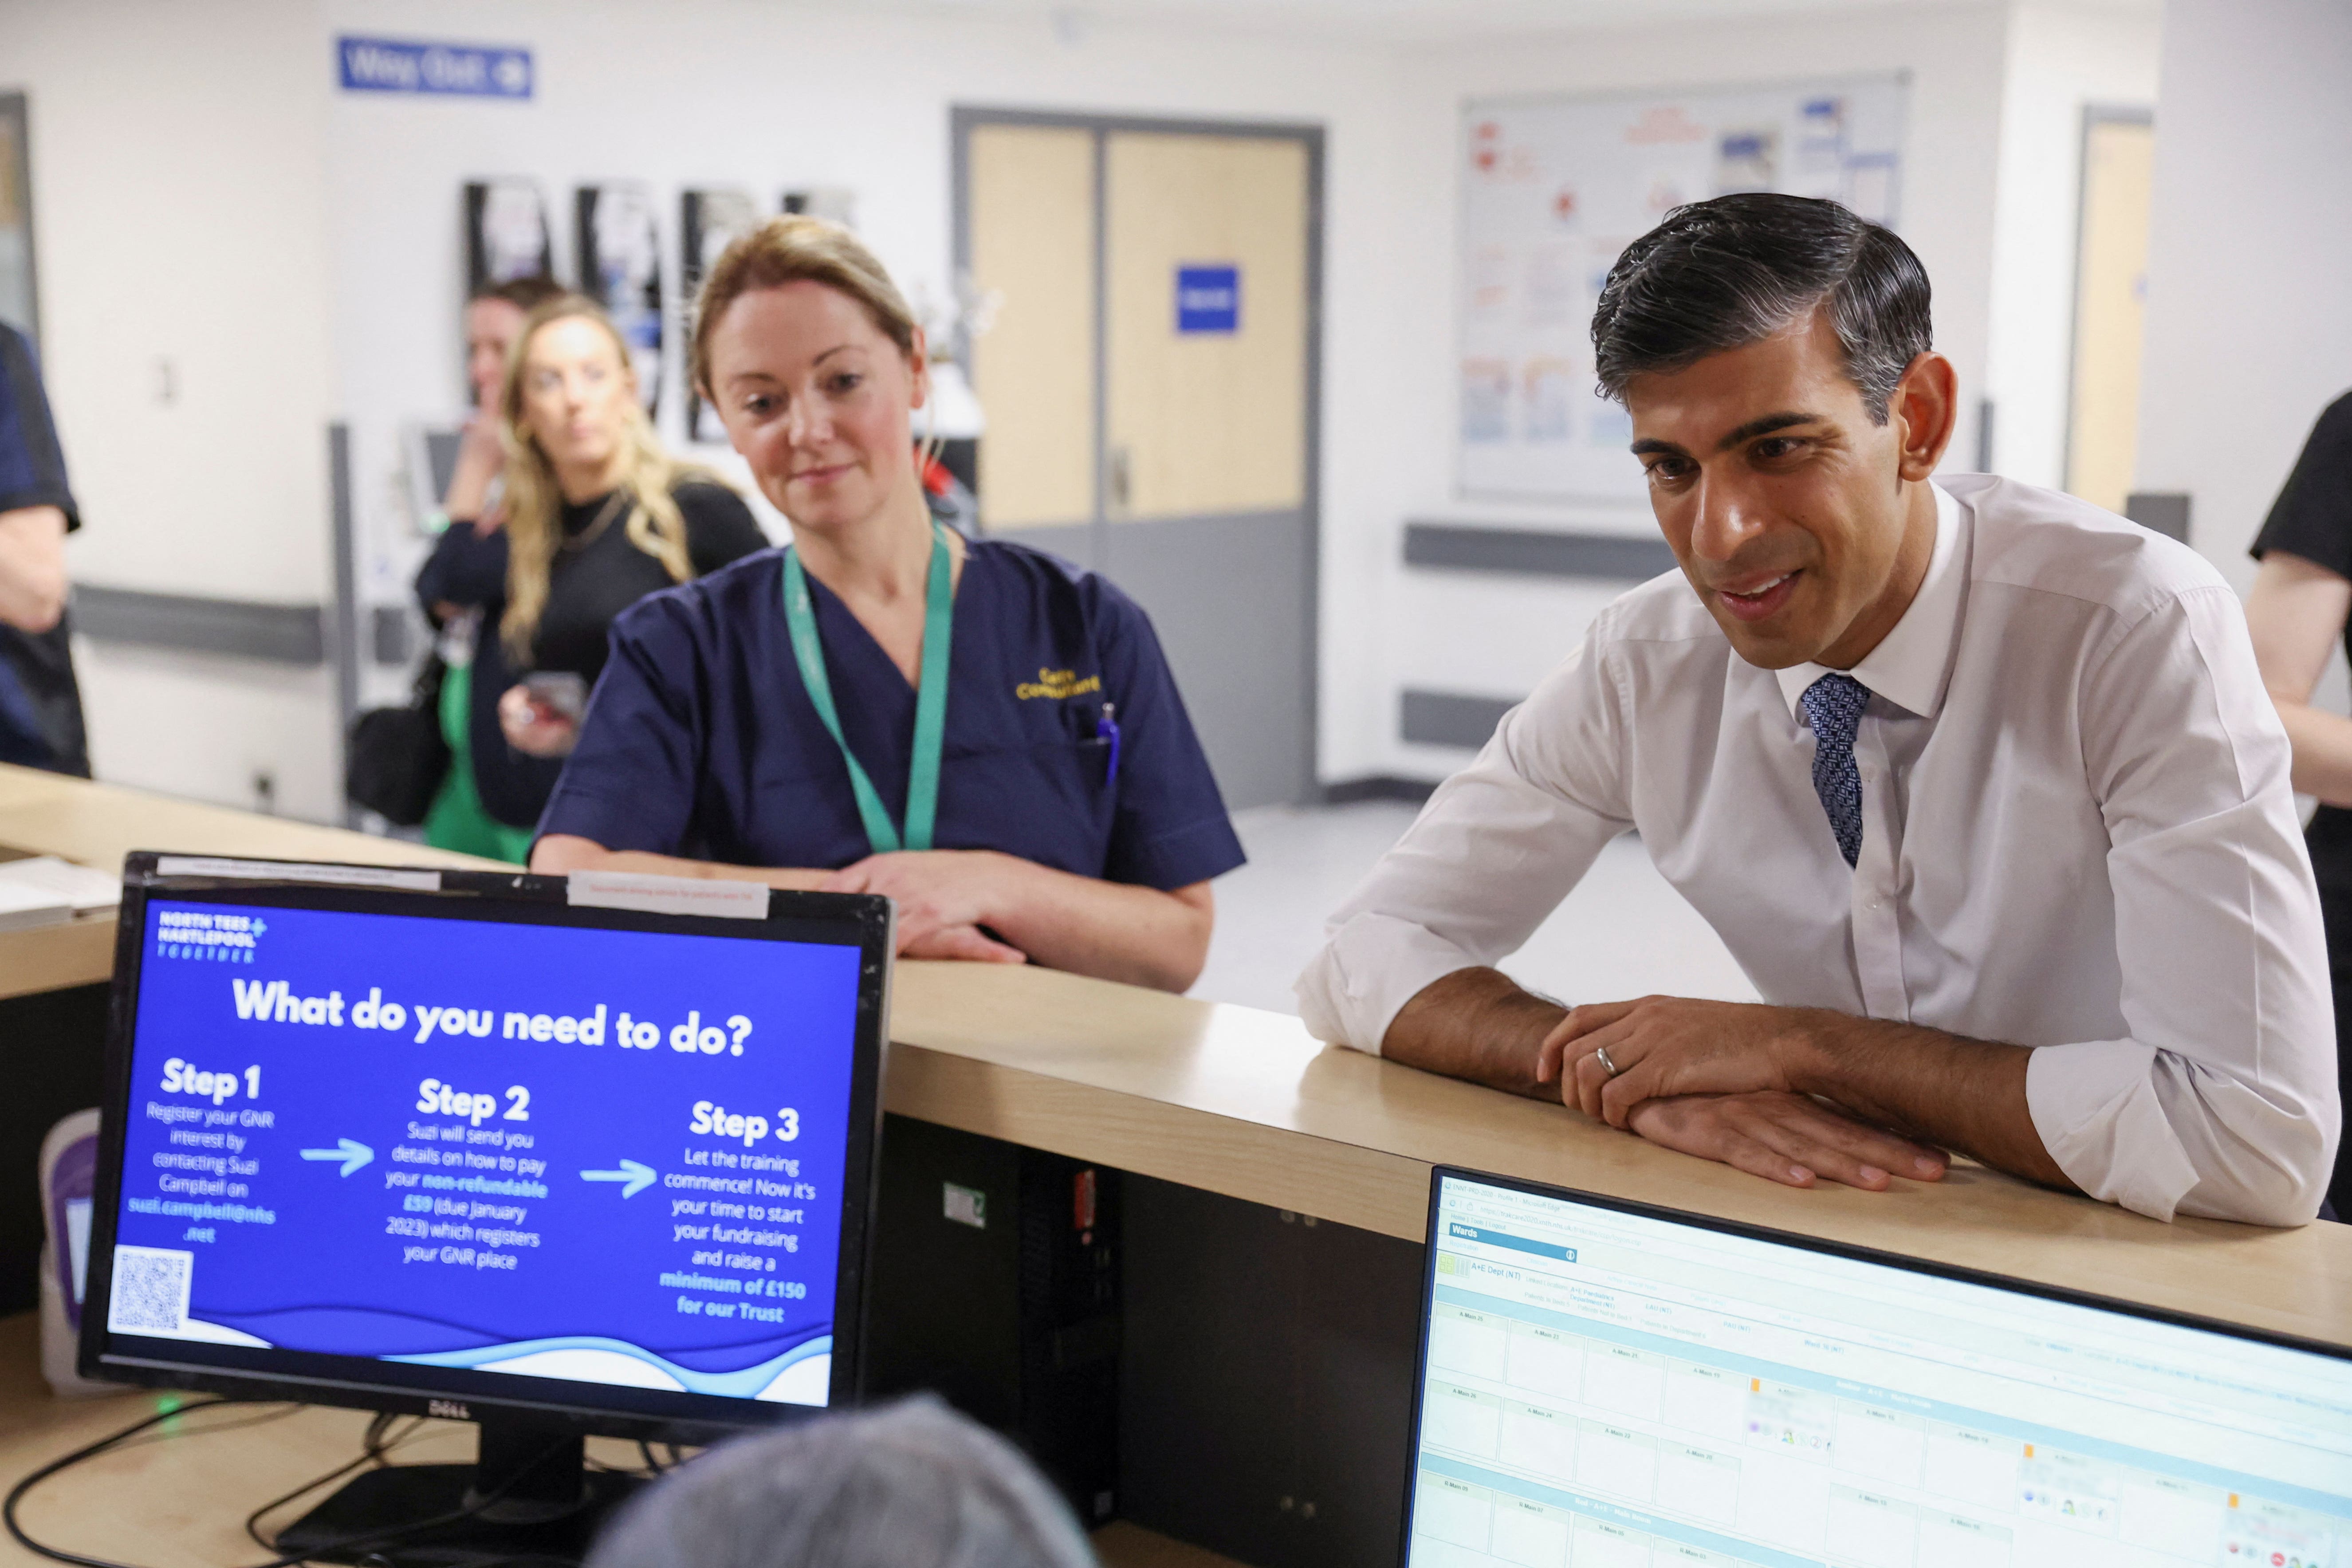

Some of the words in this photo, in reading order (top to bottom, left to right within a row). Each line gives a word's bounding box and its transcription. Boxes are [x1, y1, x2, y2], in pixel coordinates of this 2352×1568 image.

[159, 911, 213, 929] NORTH
[213, 914, 251, 932] TEES
[158, 927, 256, 948] HARTLEPOOL
[232, 979, 345, 1027] What
[351, 987, 406, 1032] do
[414, 1005, 493, 1044] you
[502, 1003, 607, 1046] need
[616, 1012, 661, 1050] to
[669, 1011, 753, 1057] do?
[160, 1057, 238, 1106] Step
[244, 1065, 261, 1099] 1
[146, 1101, 203, 1124] Register
[204, 1109, 240, 1128] your
[240, 1109, 275, 1128] GNR
[416, 1077, 496, 1127] Step
[503, 1084, 530, 1121] 2
[407, 1121, 439, 1141] Suzi
[440, 1125, 465, 1143] will
[466, 1128, 504, 1146] send
[504, 1132, 535, 1151] you
[688, 1100, 768, 1147] Step
[775, 1107, 799, 1142] 3
[170, 1127, 226, 1148] interest
[226, 1131, 247, 1154] by
[153, 1152, 228, 1176] contacting
[227, 1155, 260, 1175] Suzi
[391, 1144, 441, 1165] details
[442, 1151, 464, 1167] on
[465, 1149, 498, 1170] how
[499, 1155, 517, 1171] to
[517, 1158, 547, 1178] pay
[684, 1147, 709, 1167] Let
[712, 1149, 739, 1169] the
[740, 1153, 800, 1178] training
[159, 1173, 228, 1198] Campbell
[227, 1183, 249, 1198] on
[385, 1171, 421, 1189] your
[422, 1174, 549, 1199] non-refundable
[664, 1173, 753, 1195] commence!
[755, 1178, 792, 1198] Now
[793, 1181, 817, 1200] it's
[128, 1196, 276, 1225] suzi.campbell@nhs
[434, 1197, 469, 1216] (due
[467, 1199, 527, 1226] January
[671, 1199, 709, 1217] your
[710, 1199, 746, 1219] time
[747, 1204, 766, 1221] to
[767, 1206, 805, 1224] start
[1497, 1193, 1514, 1202] Profile
[1522, 1198, 1547, 1209] Microsoft
[1547, 1202, 1561, 1212] Edge
[385, 1216, 429, 1239] 2023)
[429, 1221, 475, 1241] which
[475, 1227, 541, 1248] registers
[1451, 1213, 1466, 1222] Home
[1471, 1217, 1484, 1226] Tools
[1488, 1220, 1506, 1230] Logout
[1451, 1223, 1478, 1238] Wards
[673, 1224, 711, 1242] your
[712, 1223, 799, 1253] fundraising
[403, 1246, 440, 1264] your
[440, 1246, 476, 1266] GNR
[476, 1250, 518, 1271] place
[691, 1249, 724, 1267] and
[724, 1251, 763, 1271] raise
[764, 1257, 776, 1272] a
[1471, 1262, 1486, 1272] A+E
[1487, 1266, 1505, 1277] Dept
[1505, 1270, 1522, 1281] (NT)
[659, 1269, 742, 1294] minimum
[744, 1277, 767, 1296] of
[764, 1279, 807, 1300] £150
[1583, 1289, 1615, 1301] Paediatrics
[676, 1295, 704, 1315] for
[704, 1301, 737, 1318] our
[738, 1302, 785, 1324] Trust
[1569, 1293, 1602, 1306] Department
[1603, 1302, 1616, 1310] (NT)
